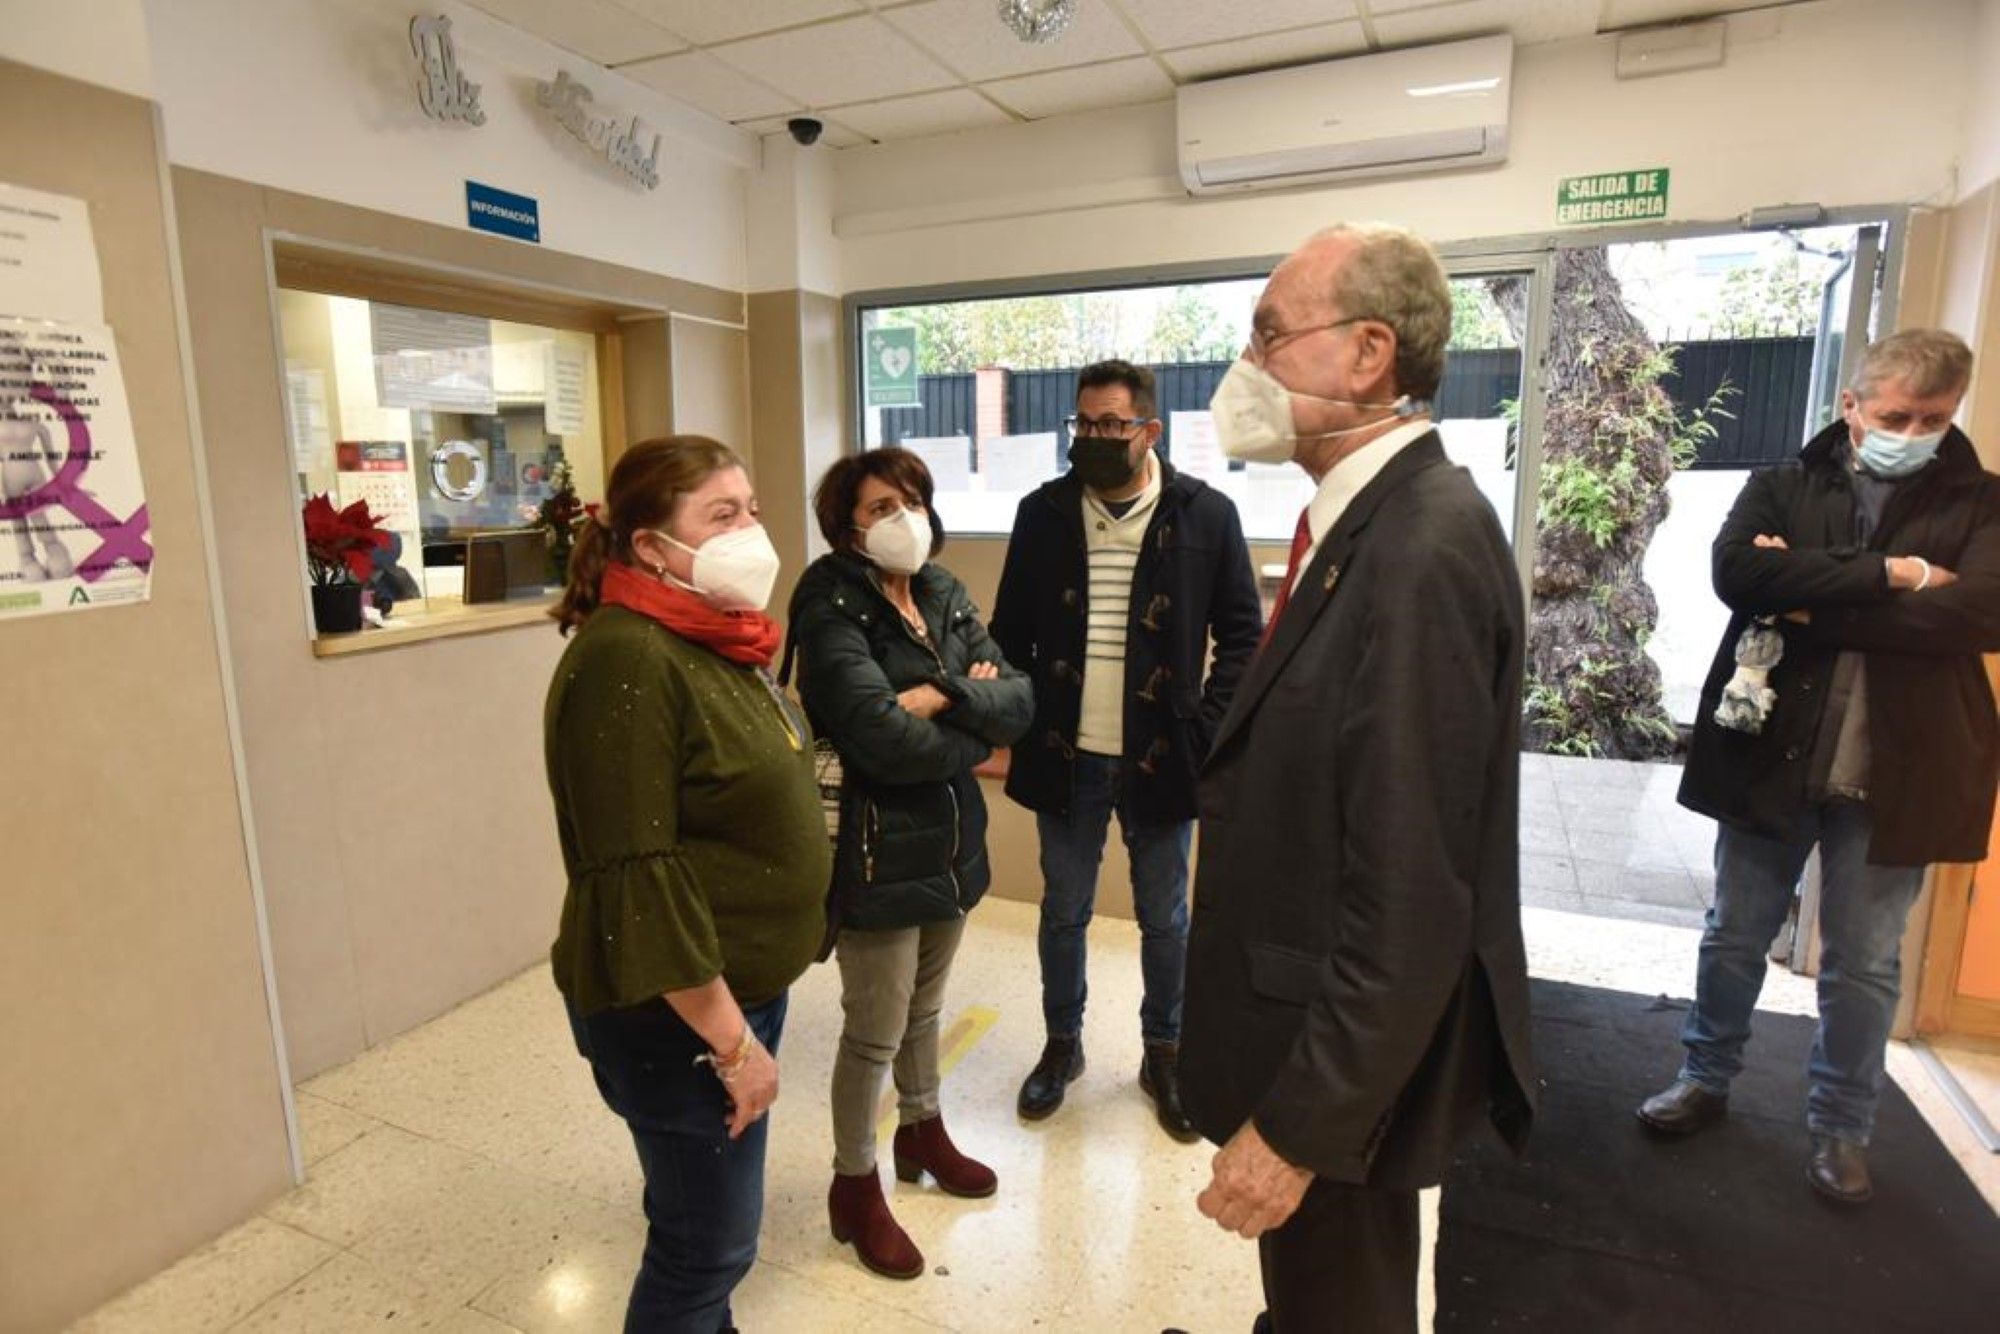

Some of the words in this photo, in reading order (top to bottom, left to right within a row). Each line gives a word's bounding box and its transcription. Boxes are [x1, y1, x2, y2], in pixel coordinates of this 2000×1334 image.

[1567, 174, 1629, 200] SALIDA
[1634, 172, 1659, 193] DE
[471, 199, 536, 226] INFORMACIÓN
[1558, 195, 1665, 222] EMERGENCIA
